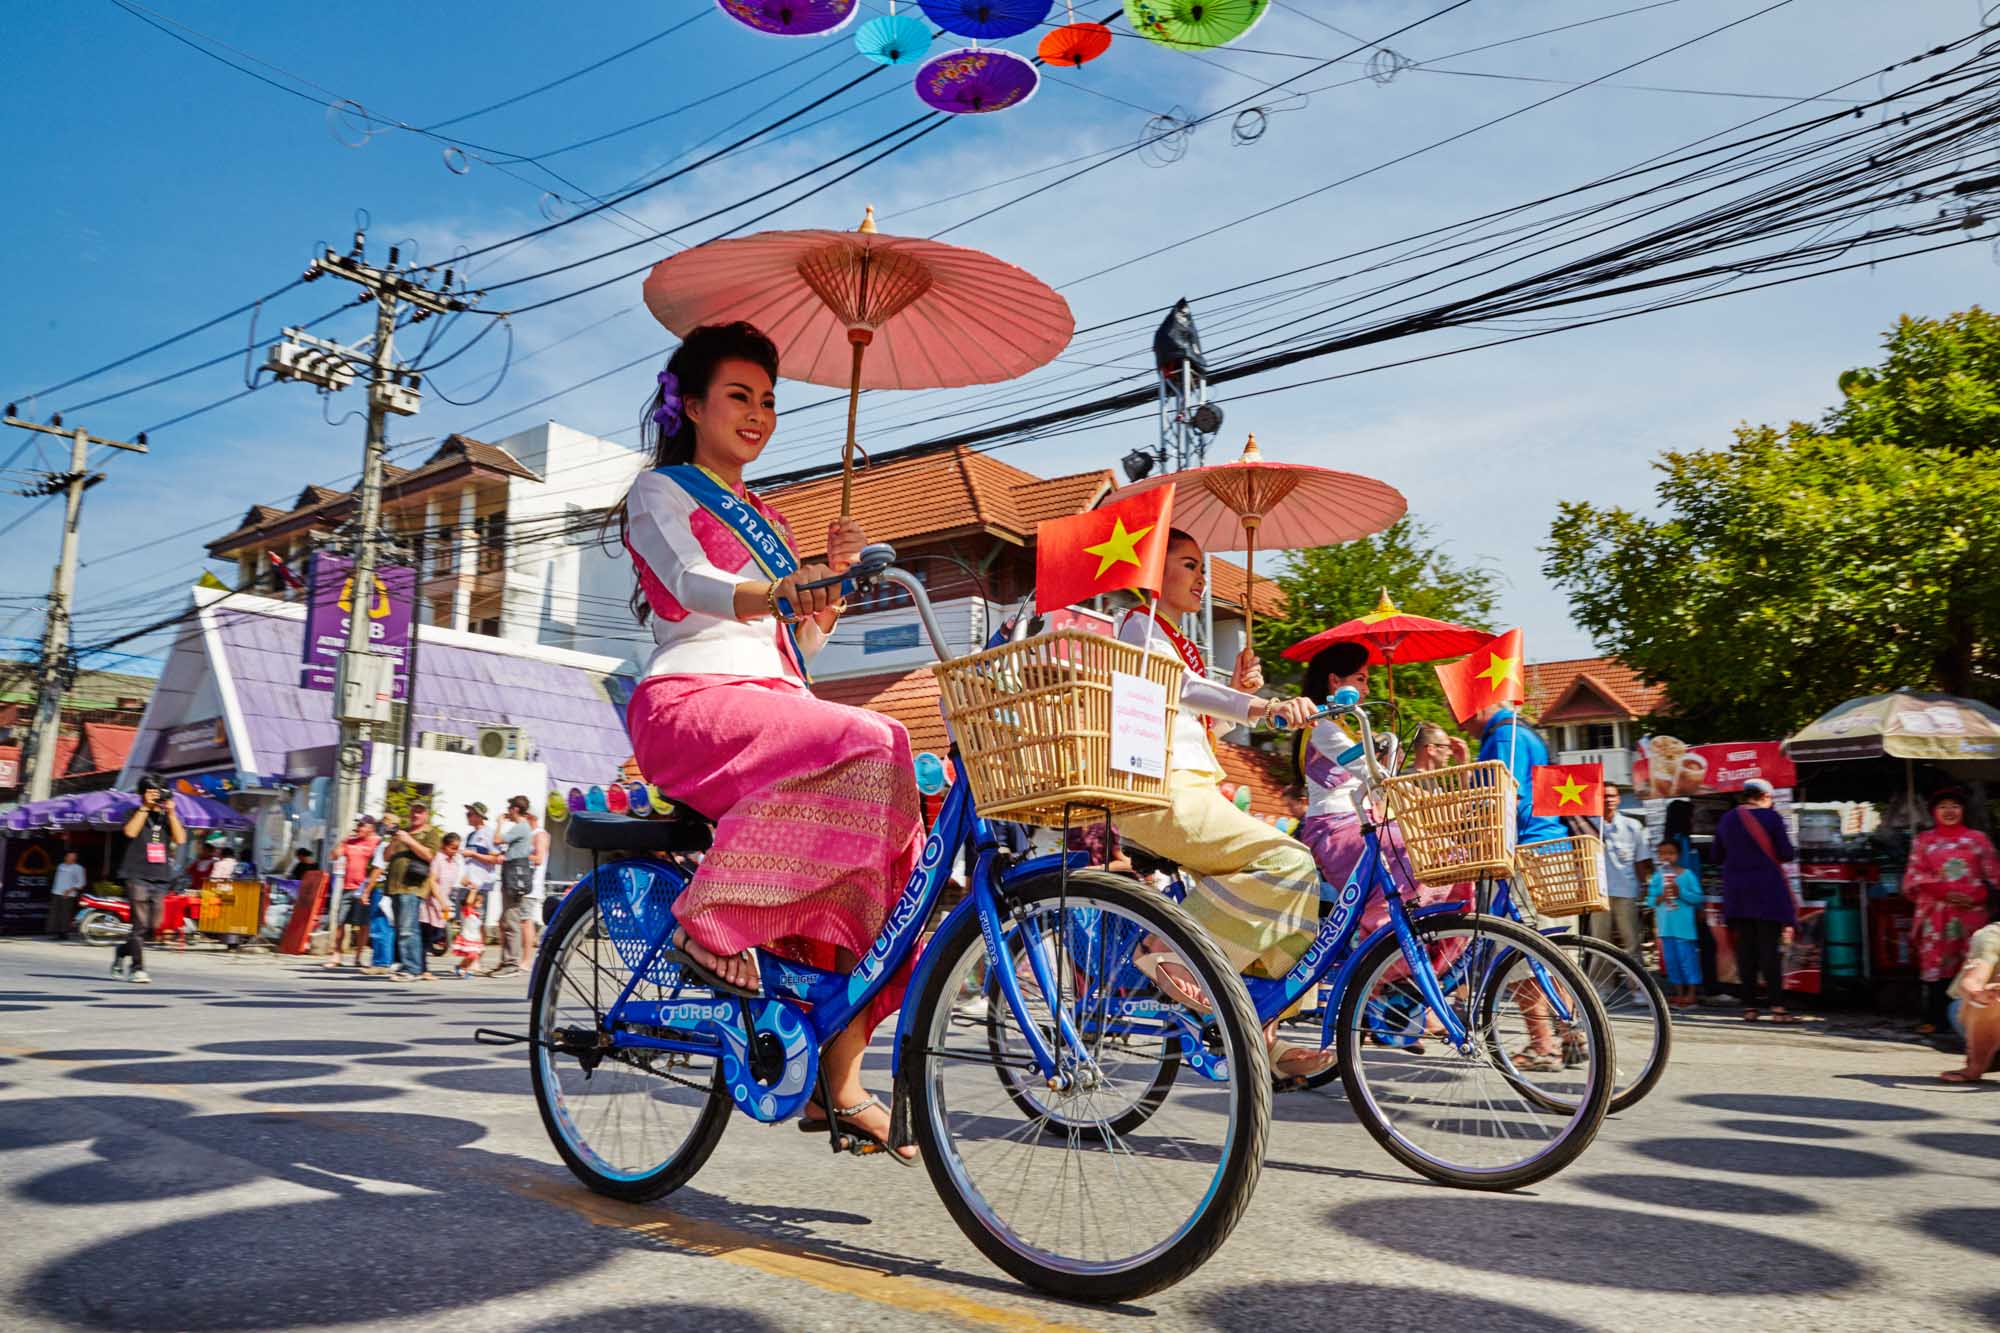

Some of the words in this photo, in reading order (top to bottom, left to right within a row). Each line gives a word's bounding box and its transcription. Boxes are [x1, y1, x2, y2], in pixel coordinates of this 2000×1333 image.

[339, 618, 385, 639] SB
[852, 833, 944, 982] TURBO
[978, 910, 999, 967] TURBO
[1287, 882, 1361, 983] TURBO
[780, 973, 818, 985] DELIGHT
[669, 1004, 725, 1020] TURBO
